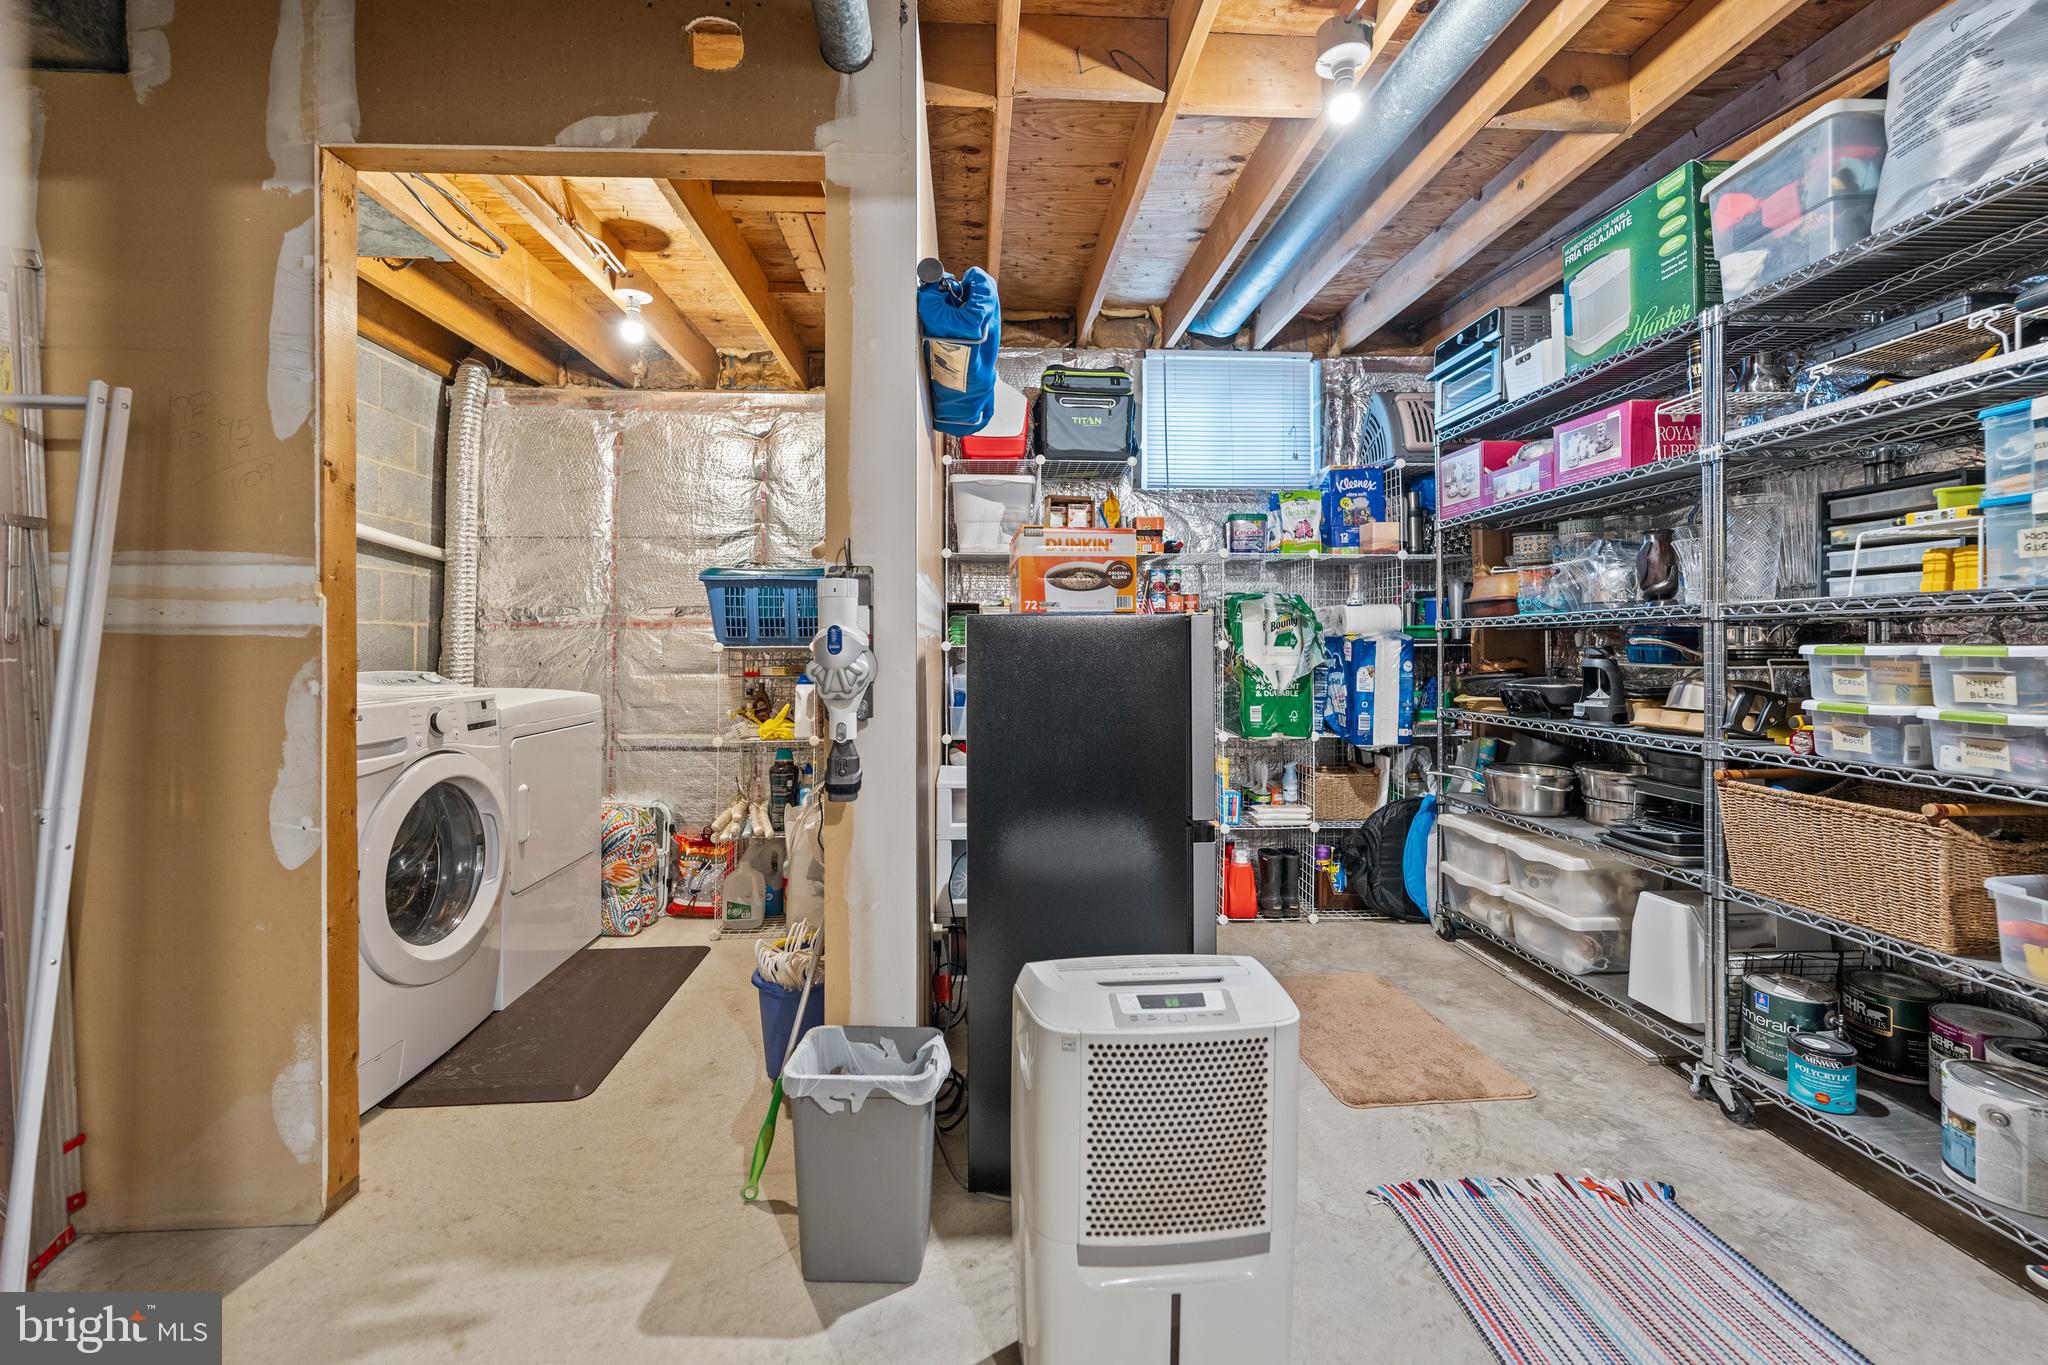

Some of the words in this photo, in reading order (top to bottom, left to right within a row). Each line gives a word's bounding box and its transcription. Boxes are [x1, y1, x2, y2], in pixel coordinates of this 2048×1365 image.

[1564, 226, 1603, 257] HUMIDIFICADOR
[1602, 222, 1611, 234] DE
[1610, 208, 1631, 226] NIEBLA
[1583, 214, 1633, 254] RELAJANTE
[1616, 303, 1691, 356] Hunter
[1072, 416, 1102, 424] TITAN
[1653, 444, 1696, 460] ALBER
[1336, 478, 1376, 492] Kleenex
[1234, 528, 1264, 536] Cascade
[1046, 538, 1113, 552] DUNKIN'
[1024, 600, 1038, 610] 72
[1270, 617, 1298, 632] Bounty
[1838, 679, 1864, 687] SCREWS
[1966, 680, 2006, 688] KNIVES
[1970, 692, 2006, 700] BLADES
[1842, 738, 1864, 746] BOLTS
[1843, 992, 1868, 1016] EHR
[1742, 1003, 1800, 1034] Emerald
[1931, 1032, 1954, 1051] BEHR
[1804, 1055, 1840, 1070] MINWAX
[1794, 1062, 1850, 1082] POLYCRYLIC
